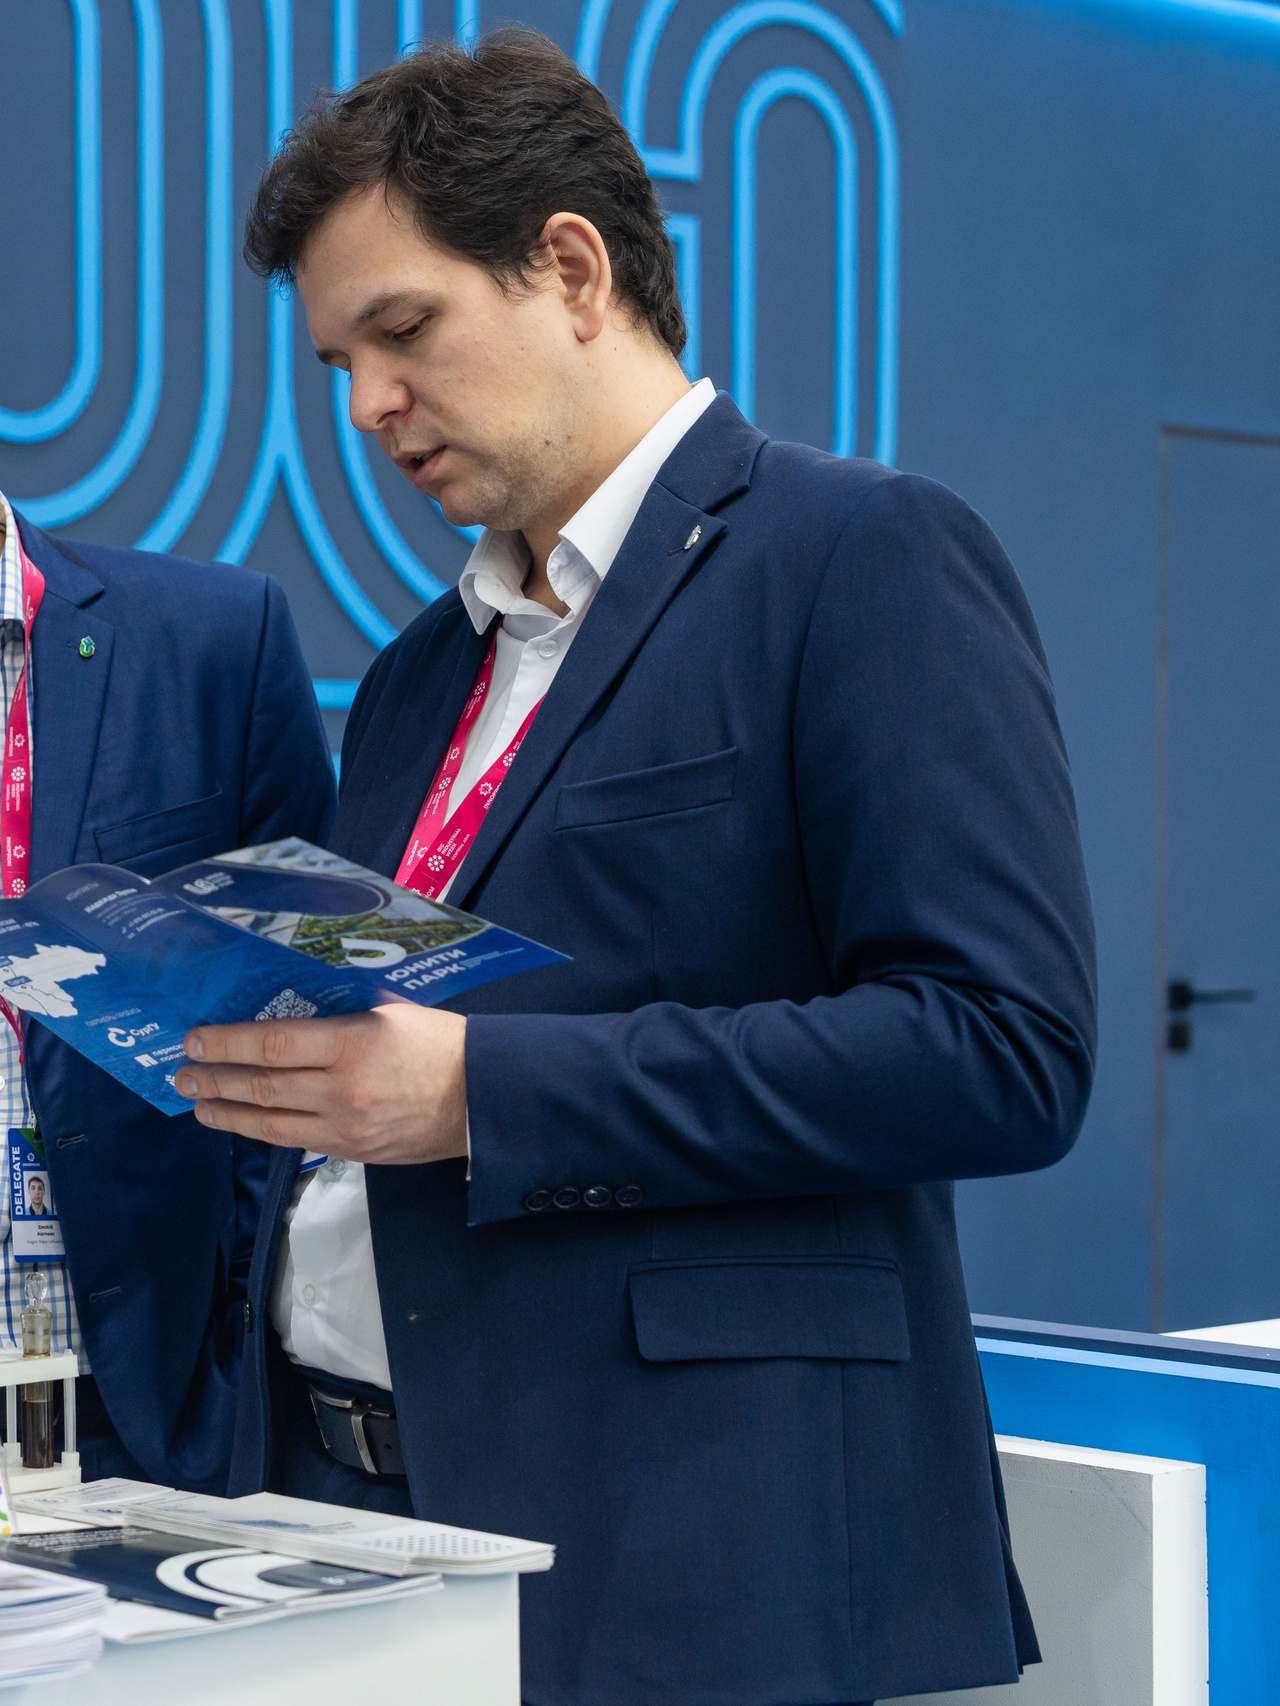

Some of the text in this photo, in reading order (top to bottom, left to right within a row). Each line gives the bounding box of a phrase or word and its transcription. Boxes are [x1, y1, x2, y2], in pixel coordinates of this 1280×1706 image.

[407, 840, 419, 866] INNOPROM
[437, 843, 445, 853] BIG
[441, 828, 461, 855] INDUSTRIAL
[446, 843, 457, 857] WEEK
[451, 834, 470, 861] CENTRAL ASIA
[384, 949, 467, 982] ЮНИТИ
[402, 963, 466, 990] ПАРК
[12, 1146, 24, 1215] DELEGATE
